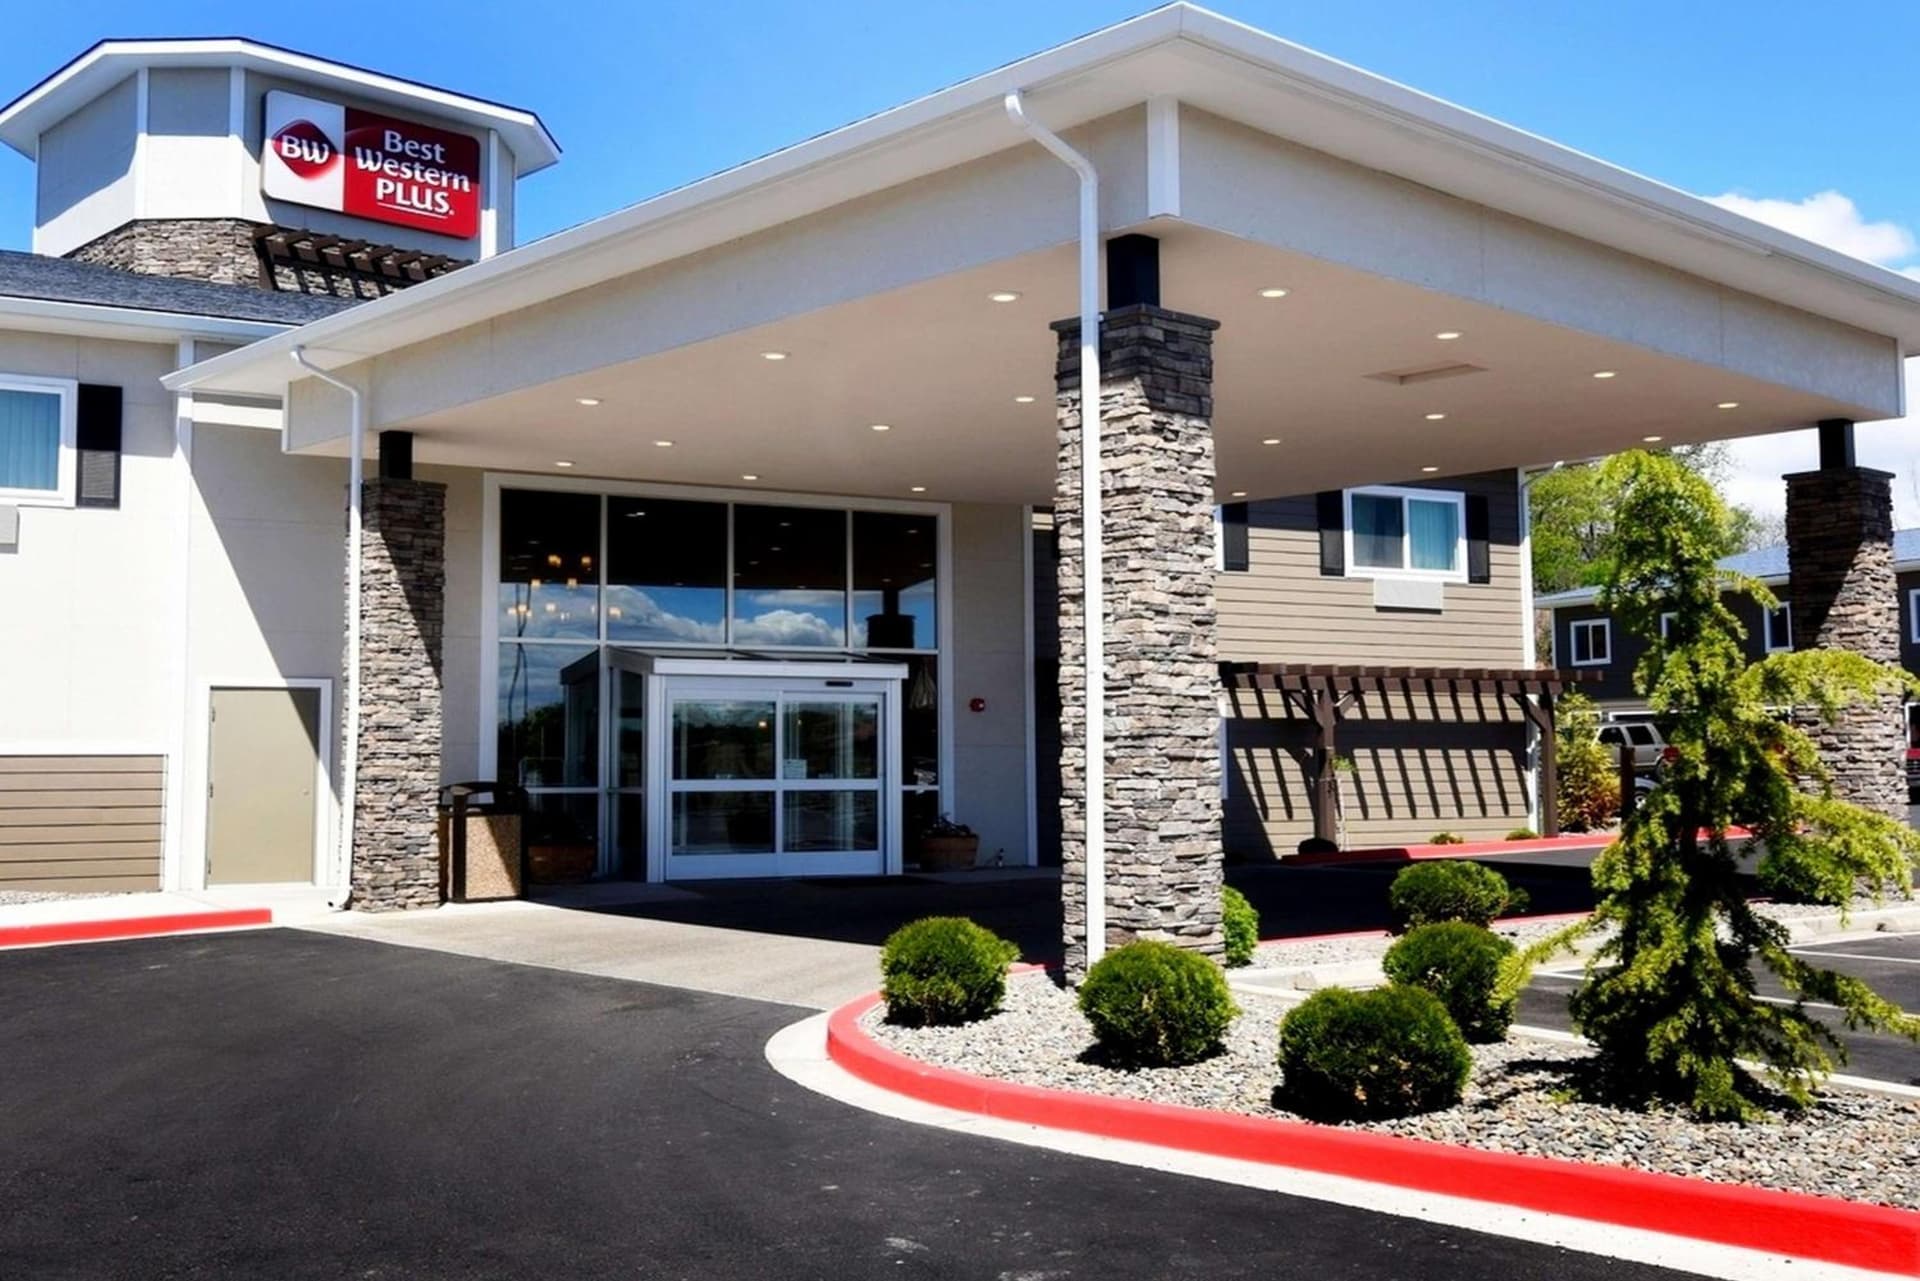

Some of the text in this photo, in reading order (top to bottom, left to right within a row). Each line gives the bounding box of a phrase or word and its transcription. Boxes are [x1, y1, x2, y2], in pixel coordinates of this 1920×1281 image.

[281, 135, 329, 164] BW
[384, 129, 446, 164] Best
[355, 147, 471, 192] Western
